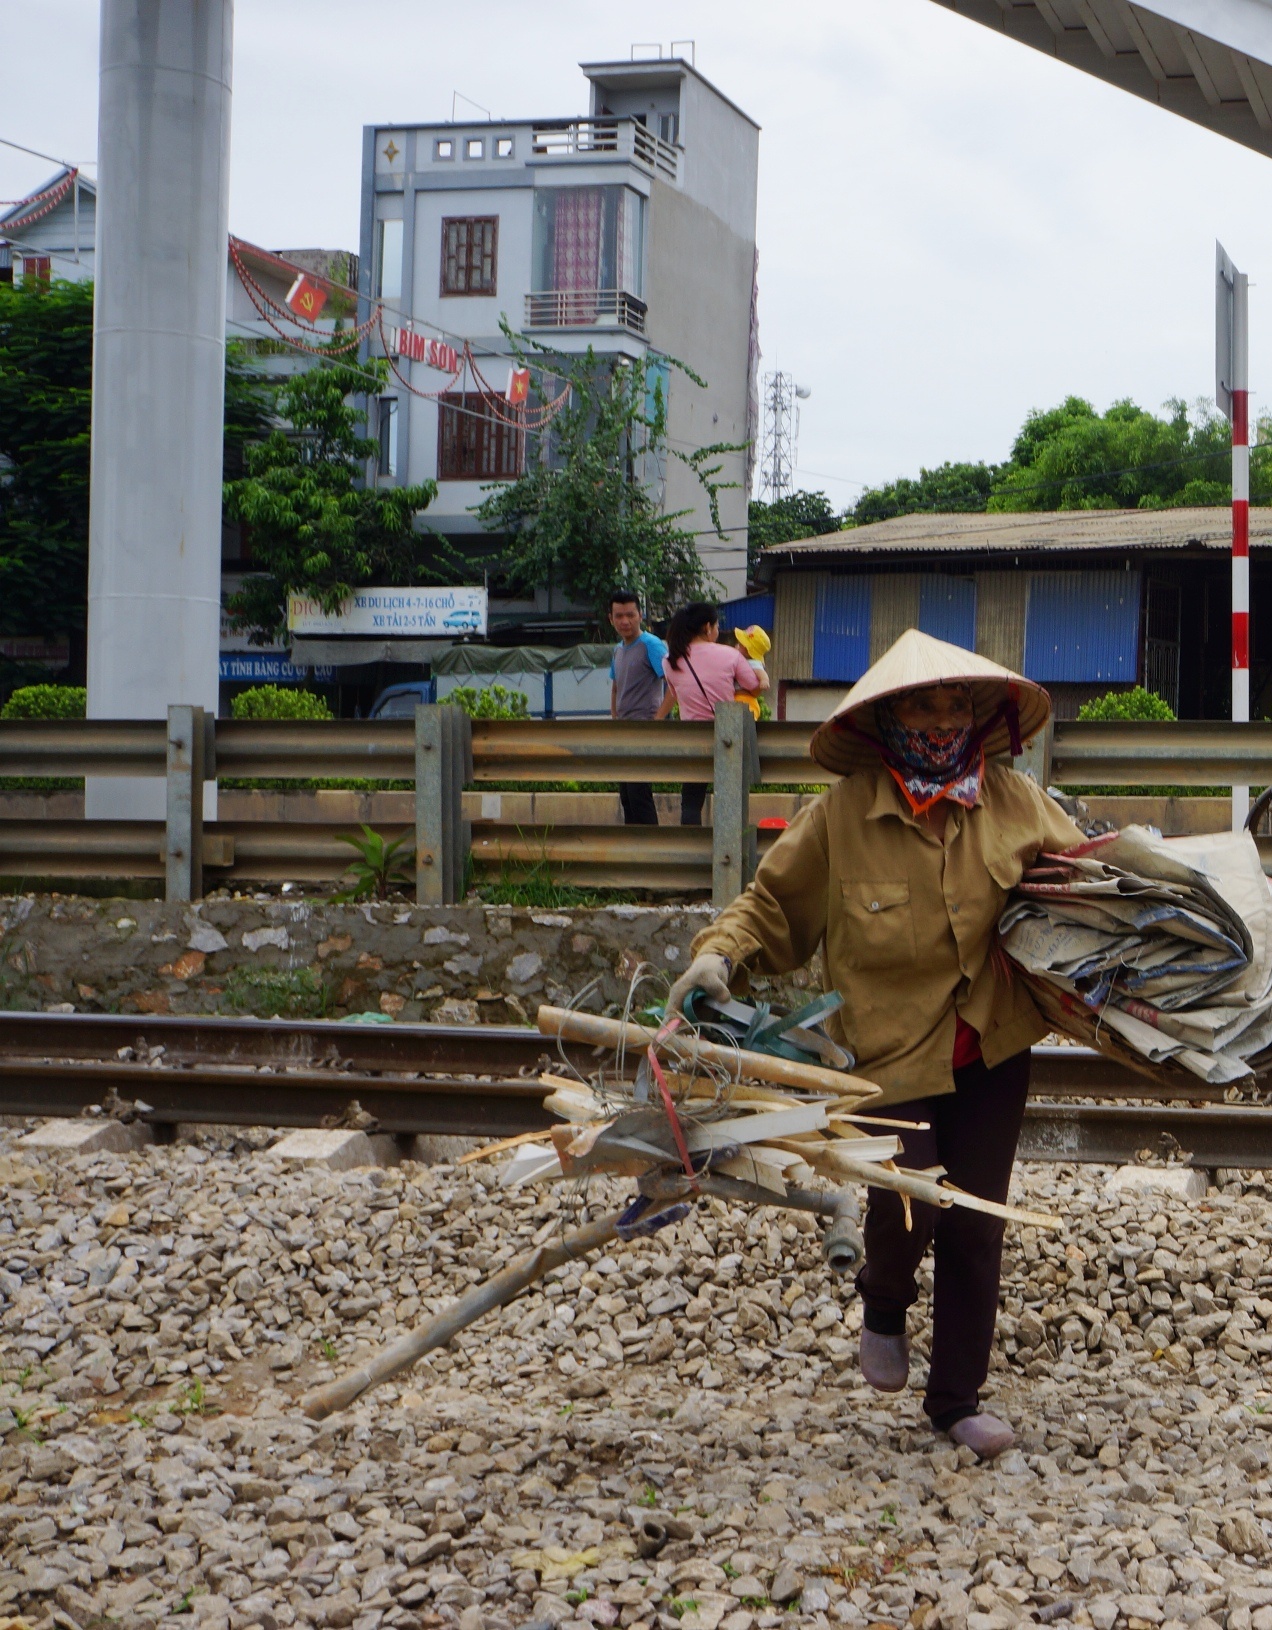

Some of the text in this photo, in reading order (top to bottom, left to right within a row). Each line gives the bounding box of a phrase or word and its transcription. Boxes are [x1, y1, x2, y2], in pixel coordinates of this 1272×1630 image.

[354, 596, 366, 608] XE
[369, 596, 380, 608] DU
[383, 596, 404, 610] LỊCH
[373, 615, 384, 626] XE
